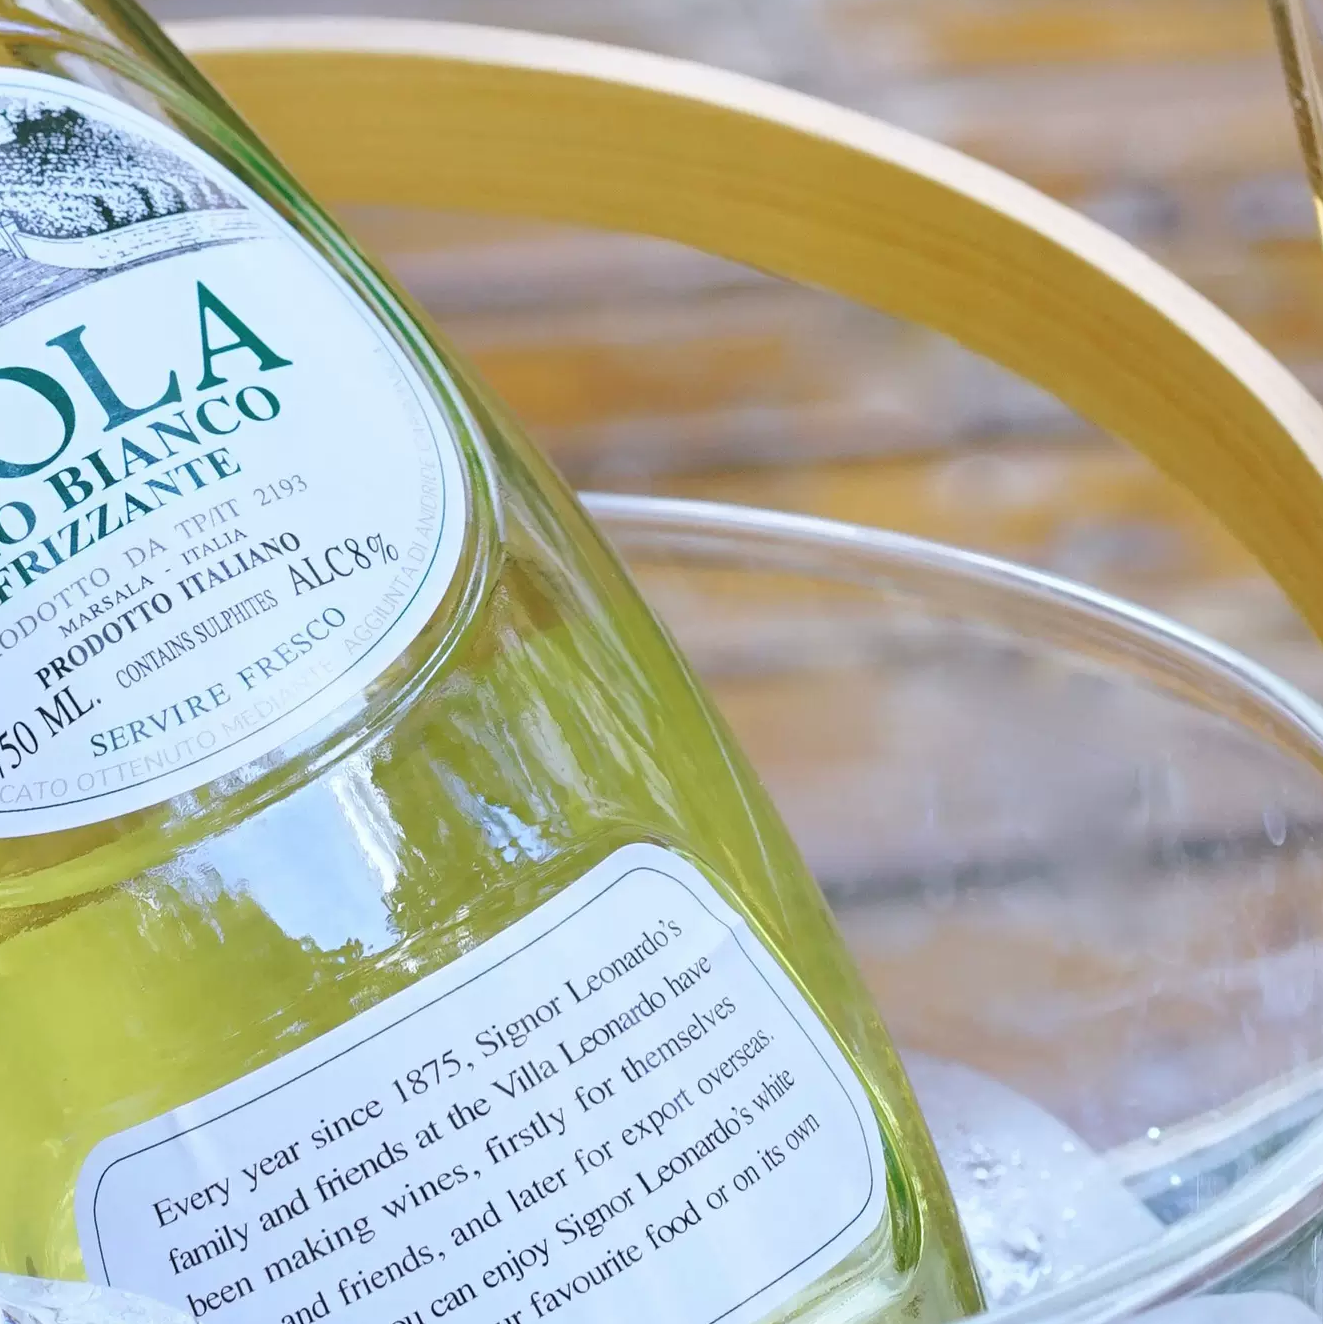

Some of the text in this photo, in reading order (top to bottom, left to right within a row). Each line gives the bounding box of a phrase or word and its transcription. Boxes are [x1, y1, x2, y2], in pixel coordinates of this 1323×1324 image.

[44, 385, 281, 513] BIANCO
[123, 537, 169, 570] DA
[174, 498, 242, 539] TP/IT
[252, 474, 308, 508] 2193
[33, 531, 301, 691] PRODOTTO ITALIANO
[34, 685, 102, 738] ML.
[115, 631, 197, 689] CONTAINS
[191, 588, 279, 645] SULPHITES
[58, 574, 155, 640] MARSALA
[181, 527, 248, 566] ITALIA
[76, 730, 216, 793] OTTENUTO
[343, 564, 420, 655] AGGIUNTA
[407, 540, 427, 566] DI
[89, 607, 347, 758] SERVIRE FRESCO
[151, 918, 683, 1229] Every year since 1875, Signor Leonardo’s
[168, 953, 713, 1275] family and friends at the Villa Leonardo have
[185, 993, 737, 1318] been making wines, firstly for themselves
[337, 1244, 447, 1306] friends,
[449, 1200, 504, 1248] and
[505, 1166, 569, 1215] later
[573, 1140, 617, 1177] for
[620, 1086, 695, 1148] export
[696, 1026, 776, 1097] overseas.
[429, 1281, 479, 1320] can
[481, 1236, 553, 1290] enjoy
[554, 1184, 638, 1246] Signor
[634, 1106, 755, 1195] Leonardo’s
[750, 1066, 797, 1113] white
[528, 1242, 645, 1320] favourite
[644, 1200, 703, 1251] food
[705, 1184, 731, 1211] or
[732, 1163, 762, 1193] on
[757, 1141, 787, 1174] its
[784, 1111, 822, 1151] own
